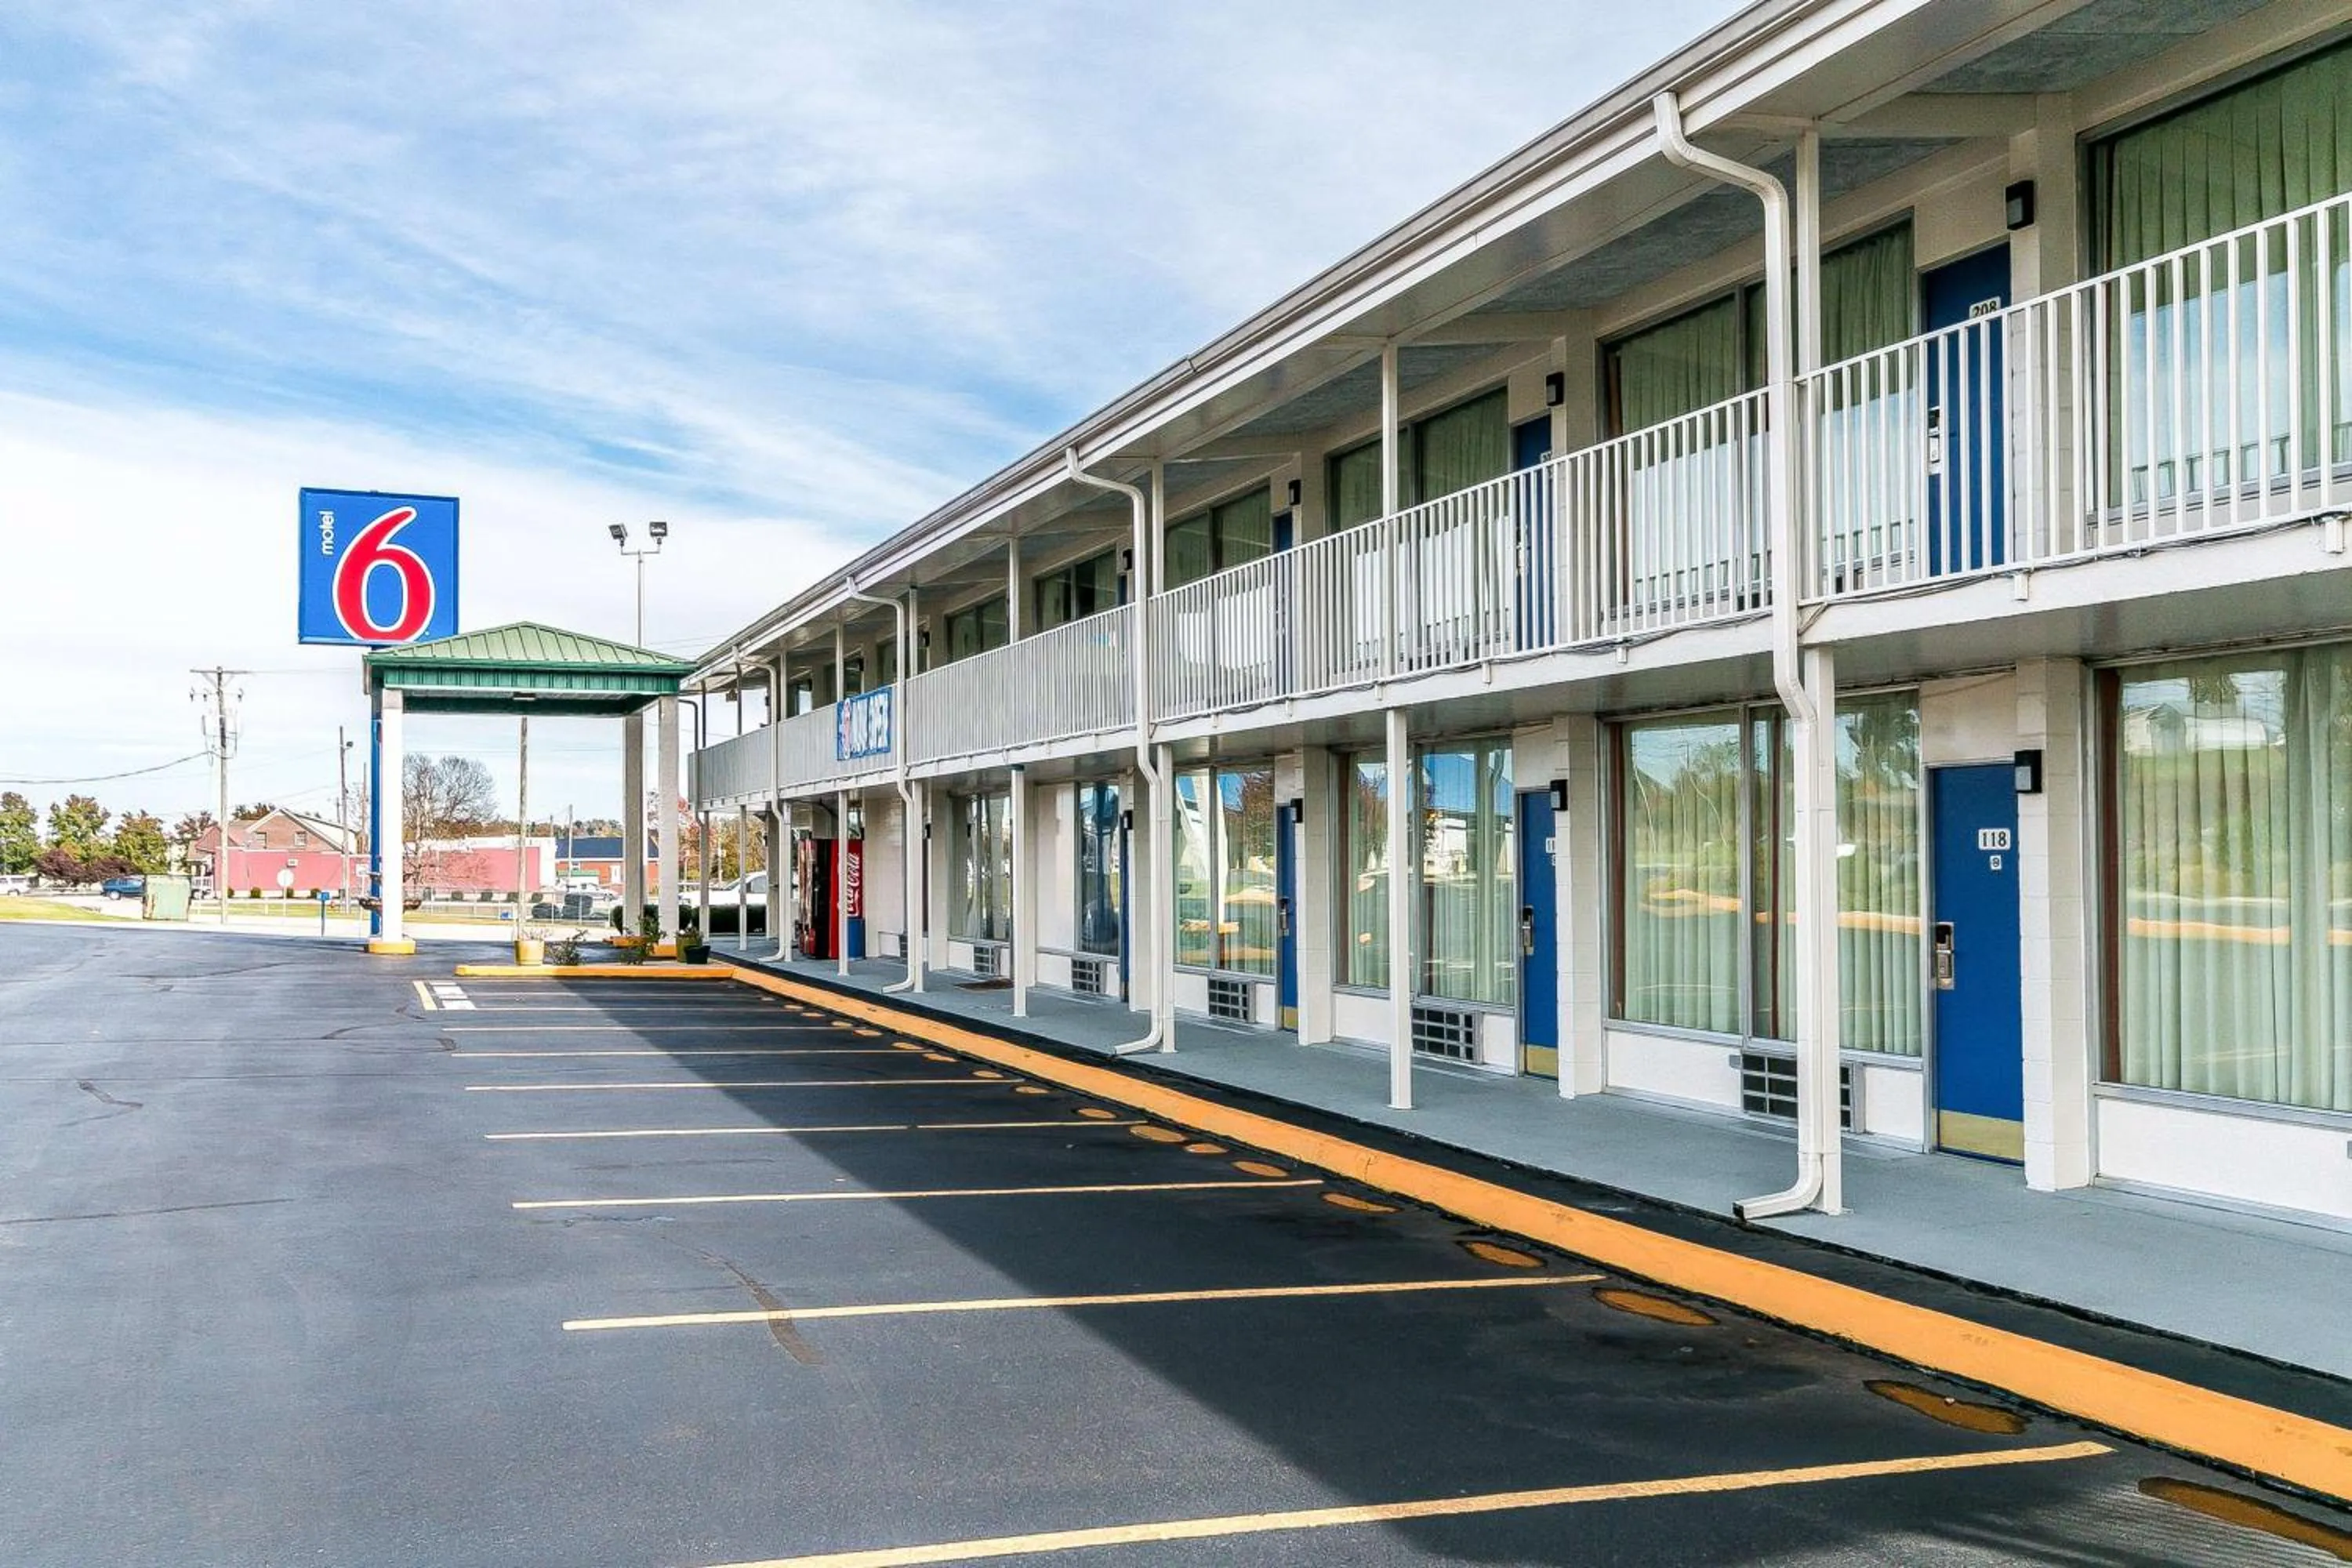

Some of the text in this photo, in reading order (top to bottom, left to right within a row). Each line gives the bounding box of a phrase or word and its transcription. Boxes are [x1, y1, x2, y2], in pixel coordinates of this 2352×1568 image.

[1973, 300, 1997, 318] 208
[319, 510, 335, 555] motel
[332, 506, 435, 643] 6
[1982, 831, 2007, 848] 118
